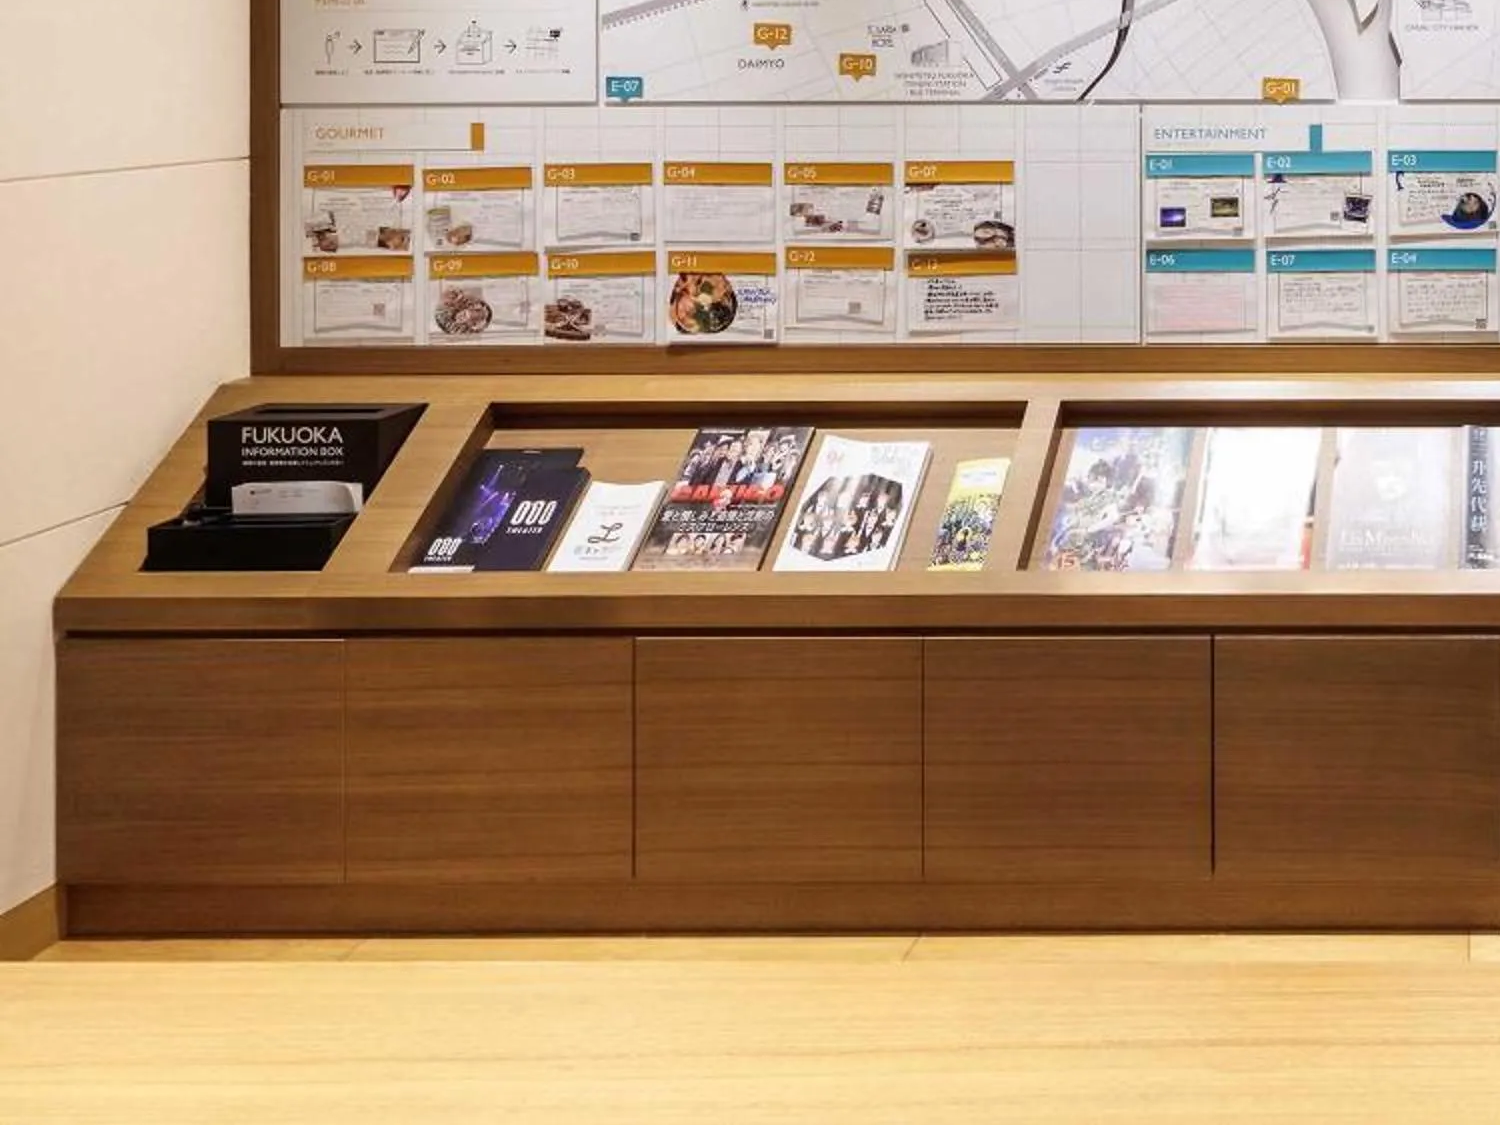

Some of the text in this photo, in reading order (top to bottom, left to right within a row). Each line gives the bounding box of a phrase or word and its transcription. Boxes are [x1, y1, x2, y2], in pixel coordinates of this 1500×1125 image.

[757, 29, 787, 40] G-12
[737, 59, 785, 69] DAIMYO
[843, 58, 873, 69] G-10
[611, 81, 639, 91] E-07
[315, 128, 384, 140] GOURMET
[1154, 128, 1267, 140] ENTERTAINMENT
[1149, 160, 1174, 171] E-01
[1266, 157, 1291, 168] E-02
[1391, 155, 1417, 166] E-03
[551, 259, 579, 269] G-10
[1150, 254, 1175, 265] E-06
[1270, 255, 1295, 266] E-07
[241, 427, 343, 443] FUKUOKA
[241, 447, 343, 456] INFORMATION BOX
